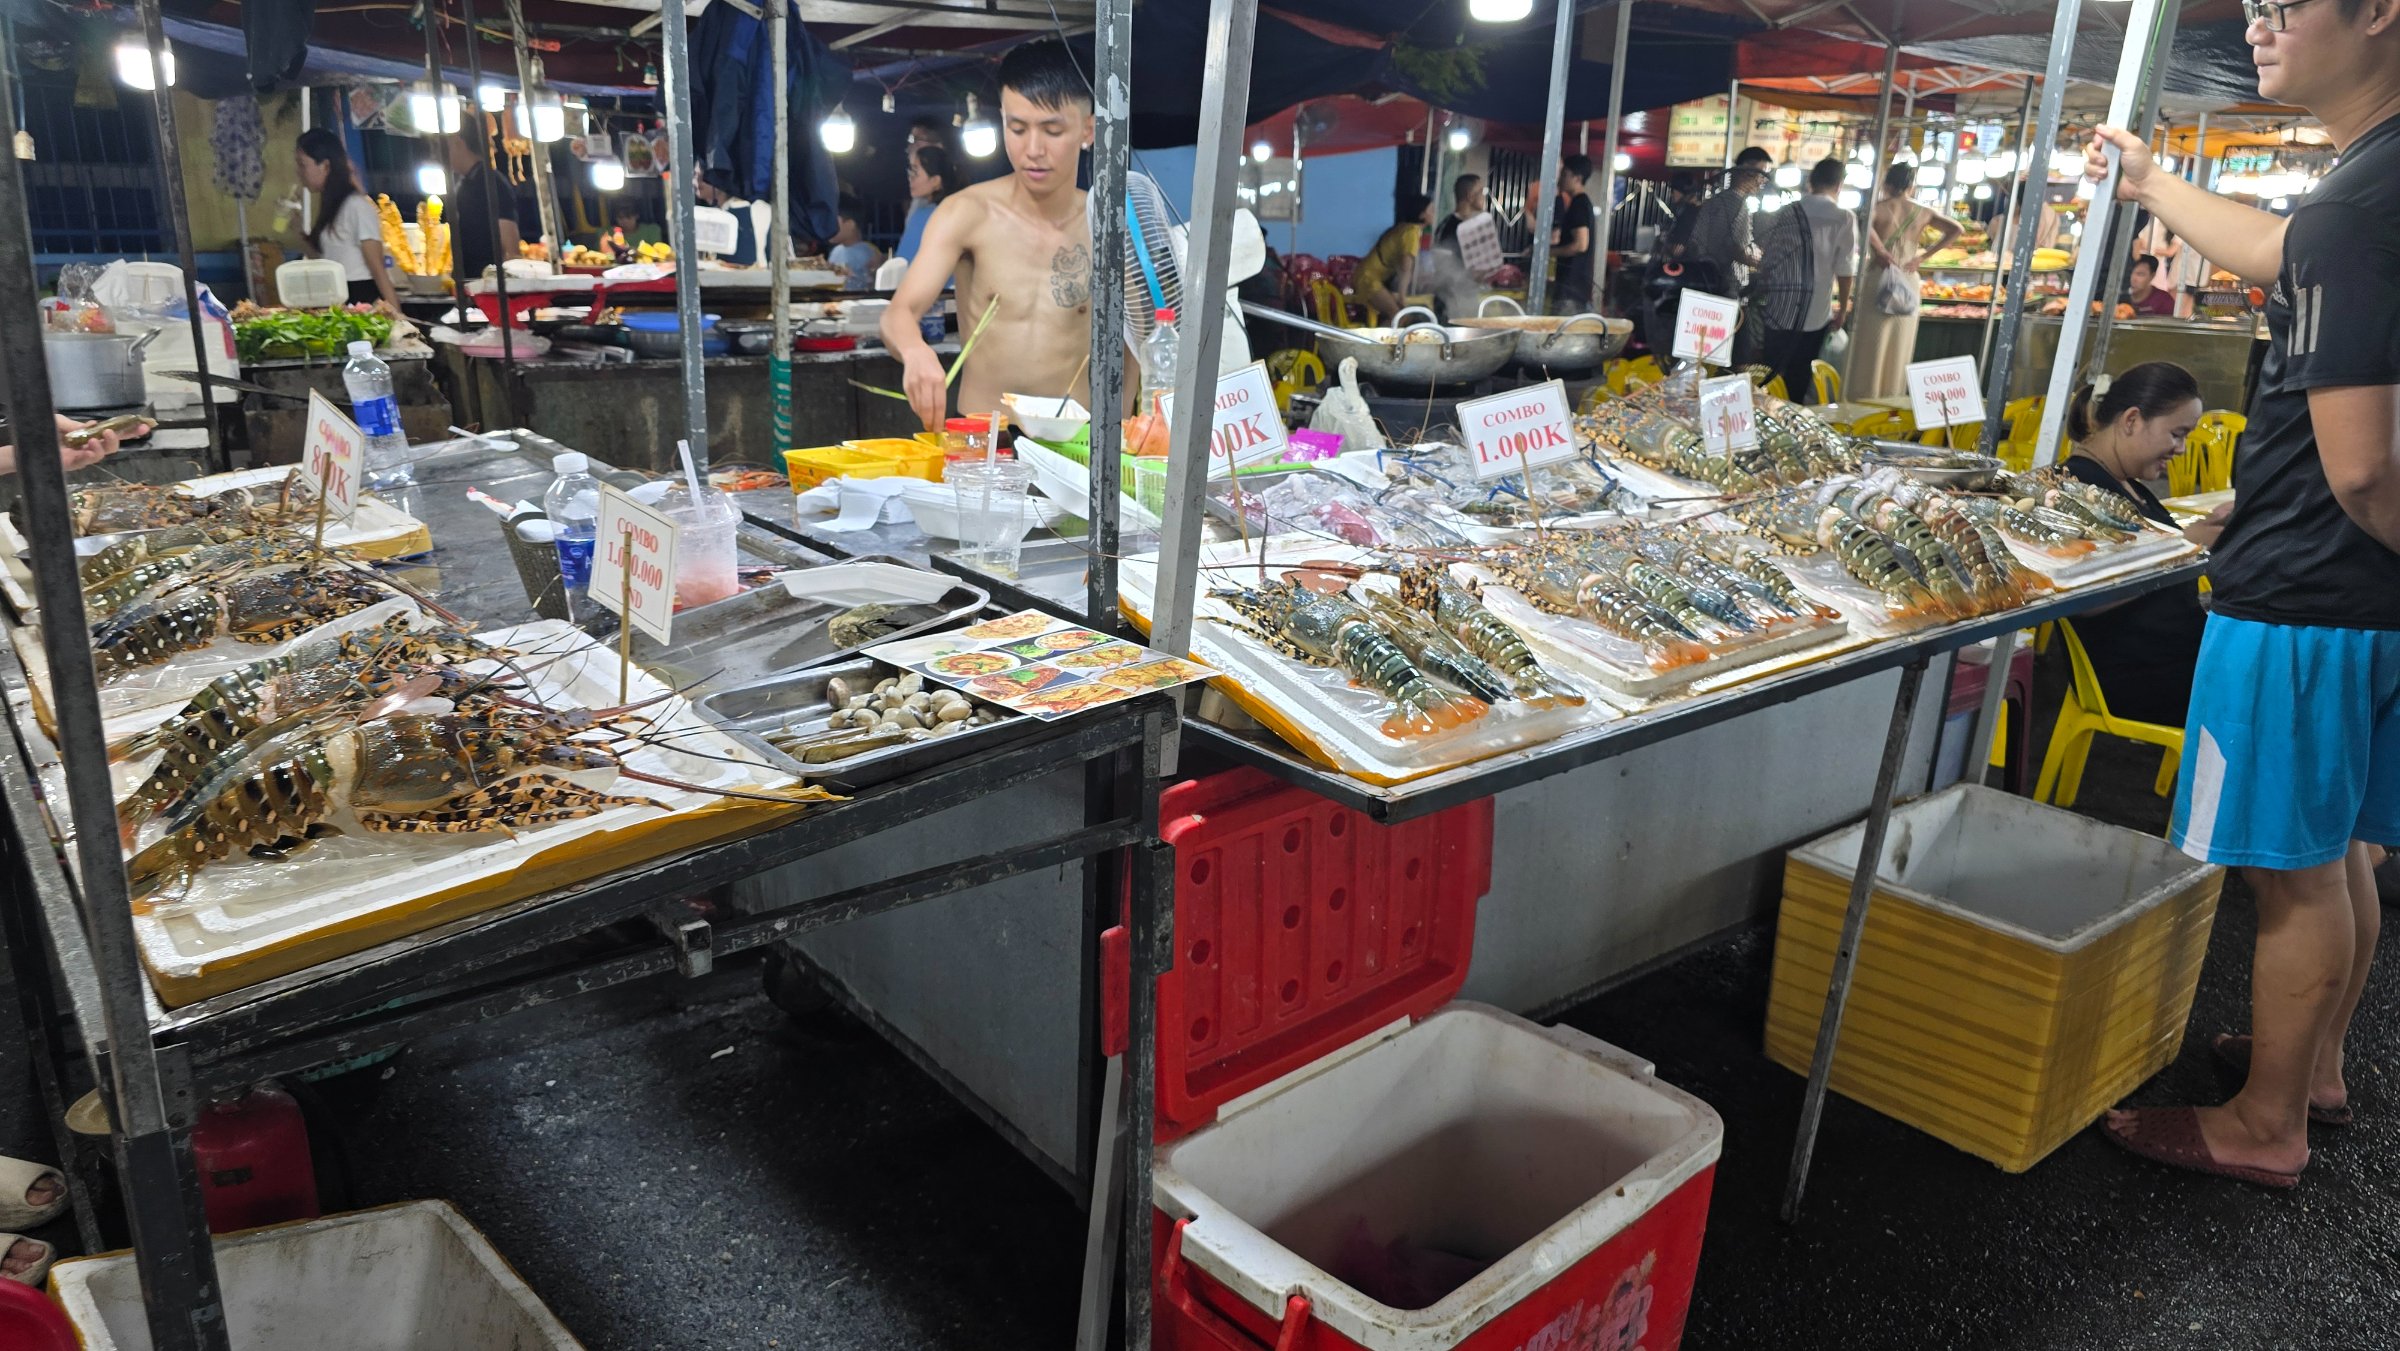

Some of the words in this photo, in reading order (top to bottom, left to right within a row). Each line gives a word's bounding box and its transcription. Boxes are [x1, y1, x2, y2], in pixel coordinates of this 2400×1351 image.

[1692, 307, 1723, 321] COMBO
[1923, 371, 1961, 386] COMBO
[1214, 388, 1249, 412] MBO
[1925, 386, 1966, 404] 500.000
[1483, 402, 1545, 428] COMBO
[1210, 412, 1271, 458] 00K
[1477, 422, 1568, 464] 1.000K
[617, 517, 659, 553] COMBO
[608, 541, 663, 591] 1.00.000
